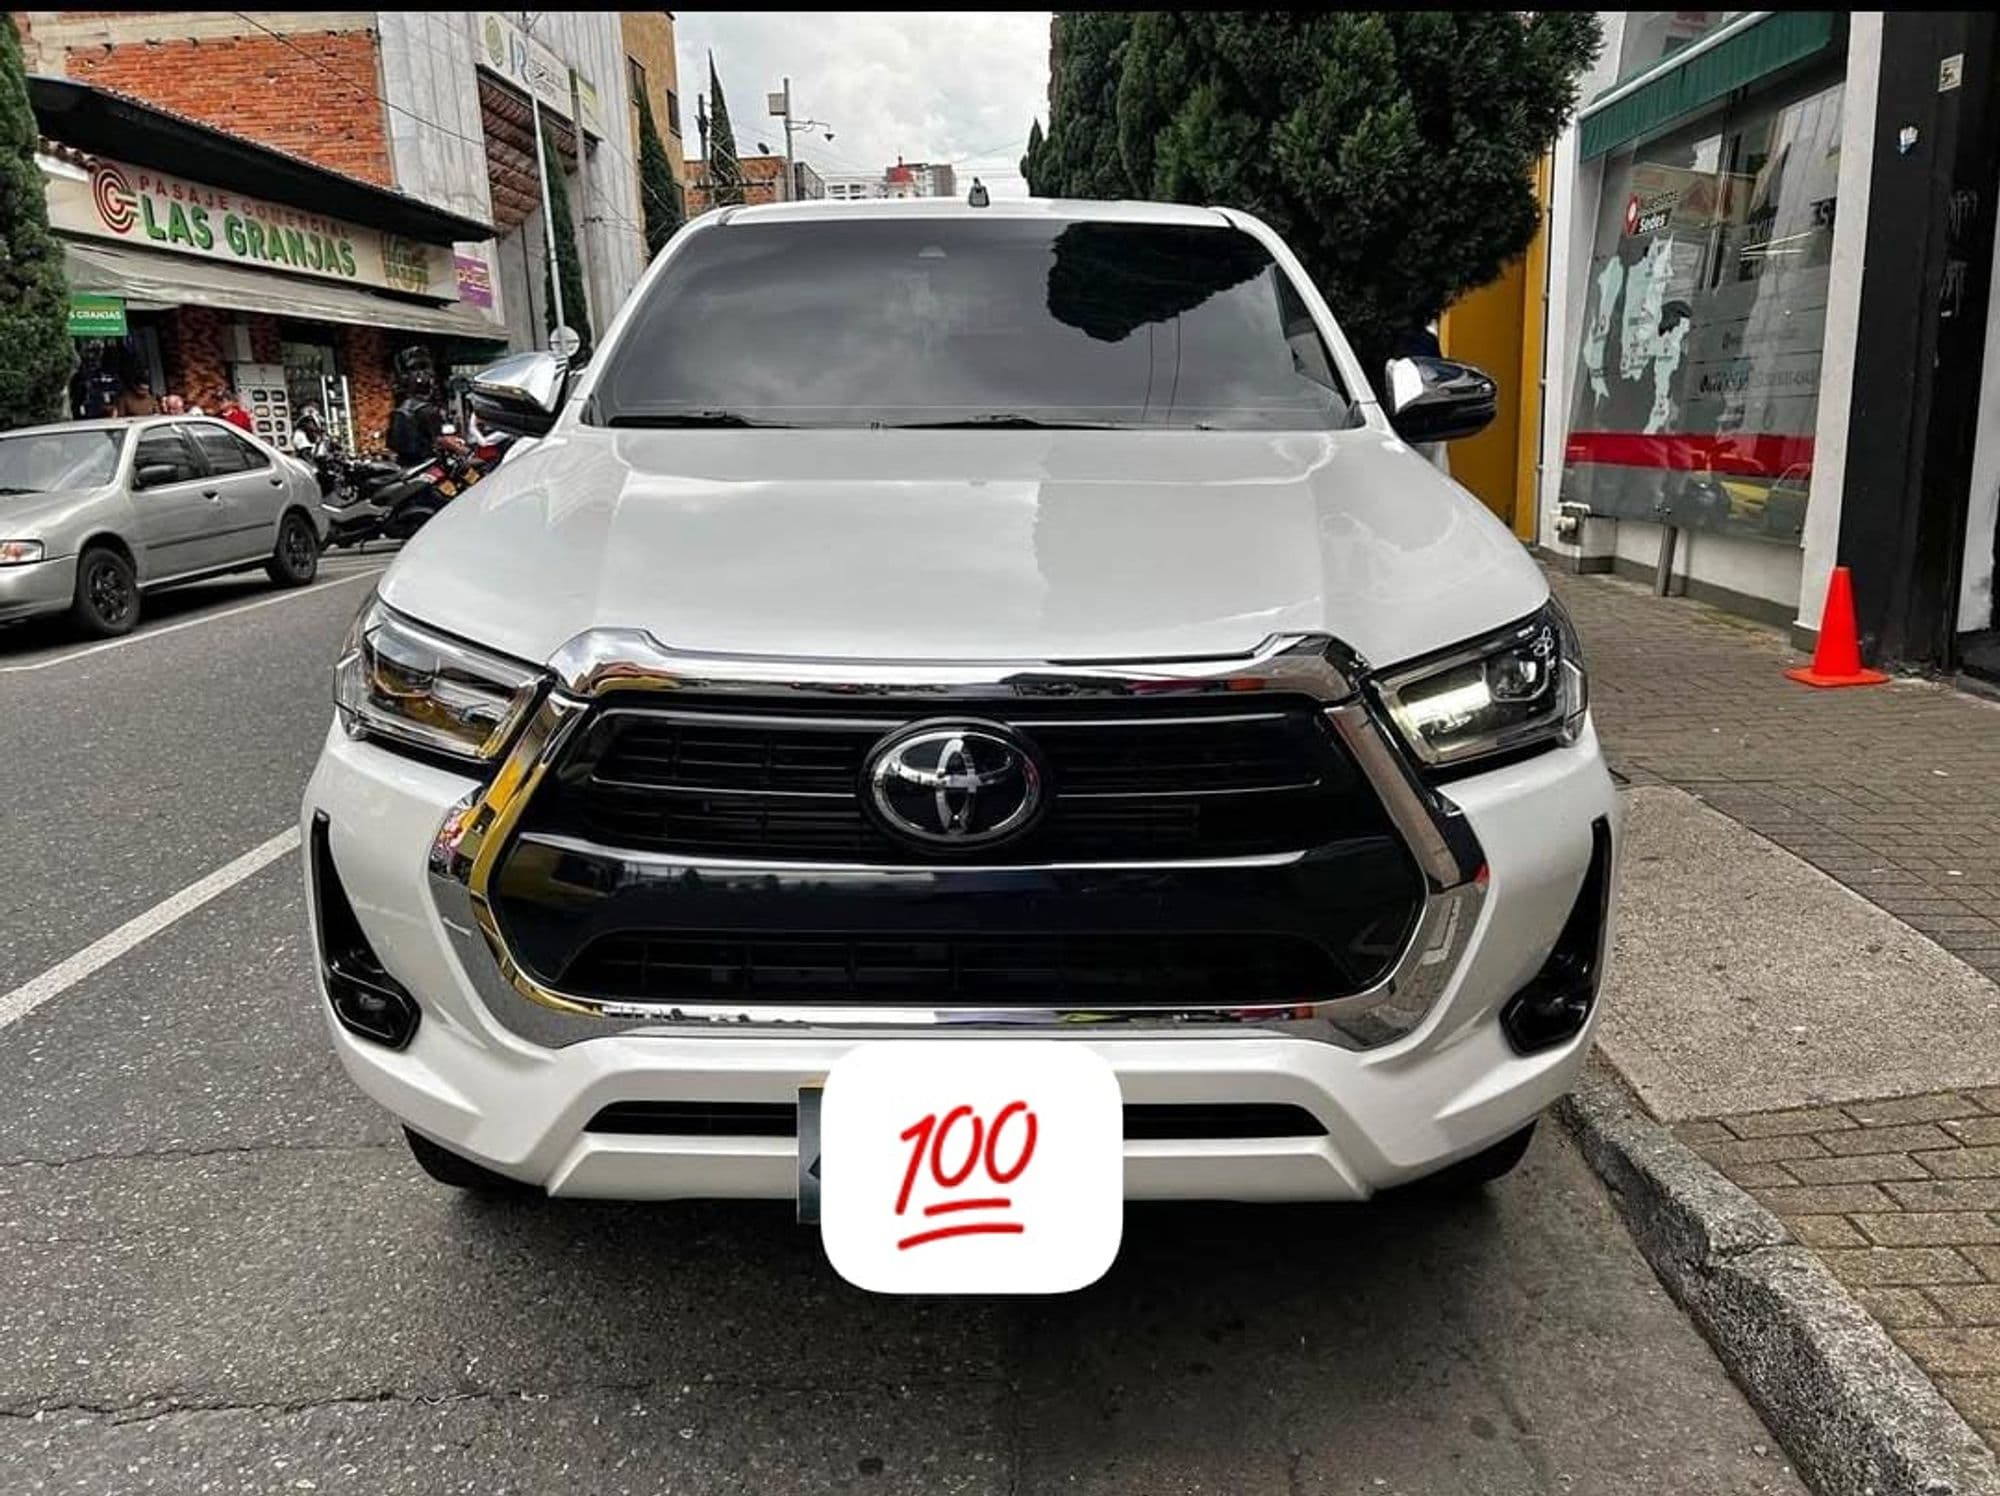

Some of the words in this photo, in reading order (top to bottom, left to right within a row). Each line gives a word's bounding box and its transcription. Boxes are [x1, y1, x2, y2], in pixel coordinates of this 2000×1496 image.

[139, 175, 229, 210] PASAJE
[140, 193, 214, 250] LAS
[223, 212, 357, 278] GRANJAS
